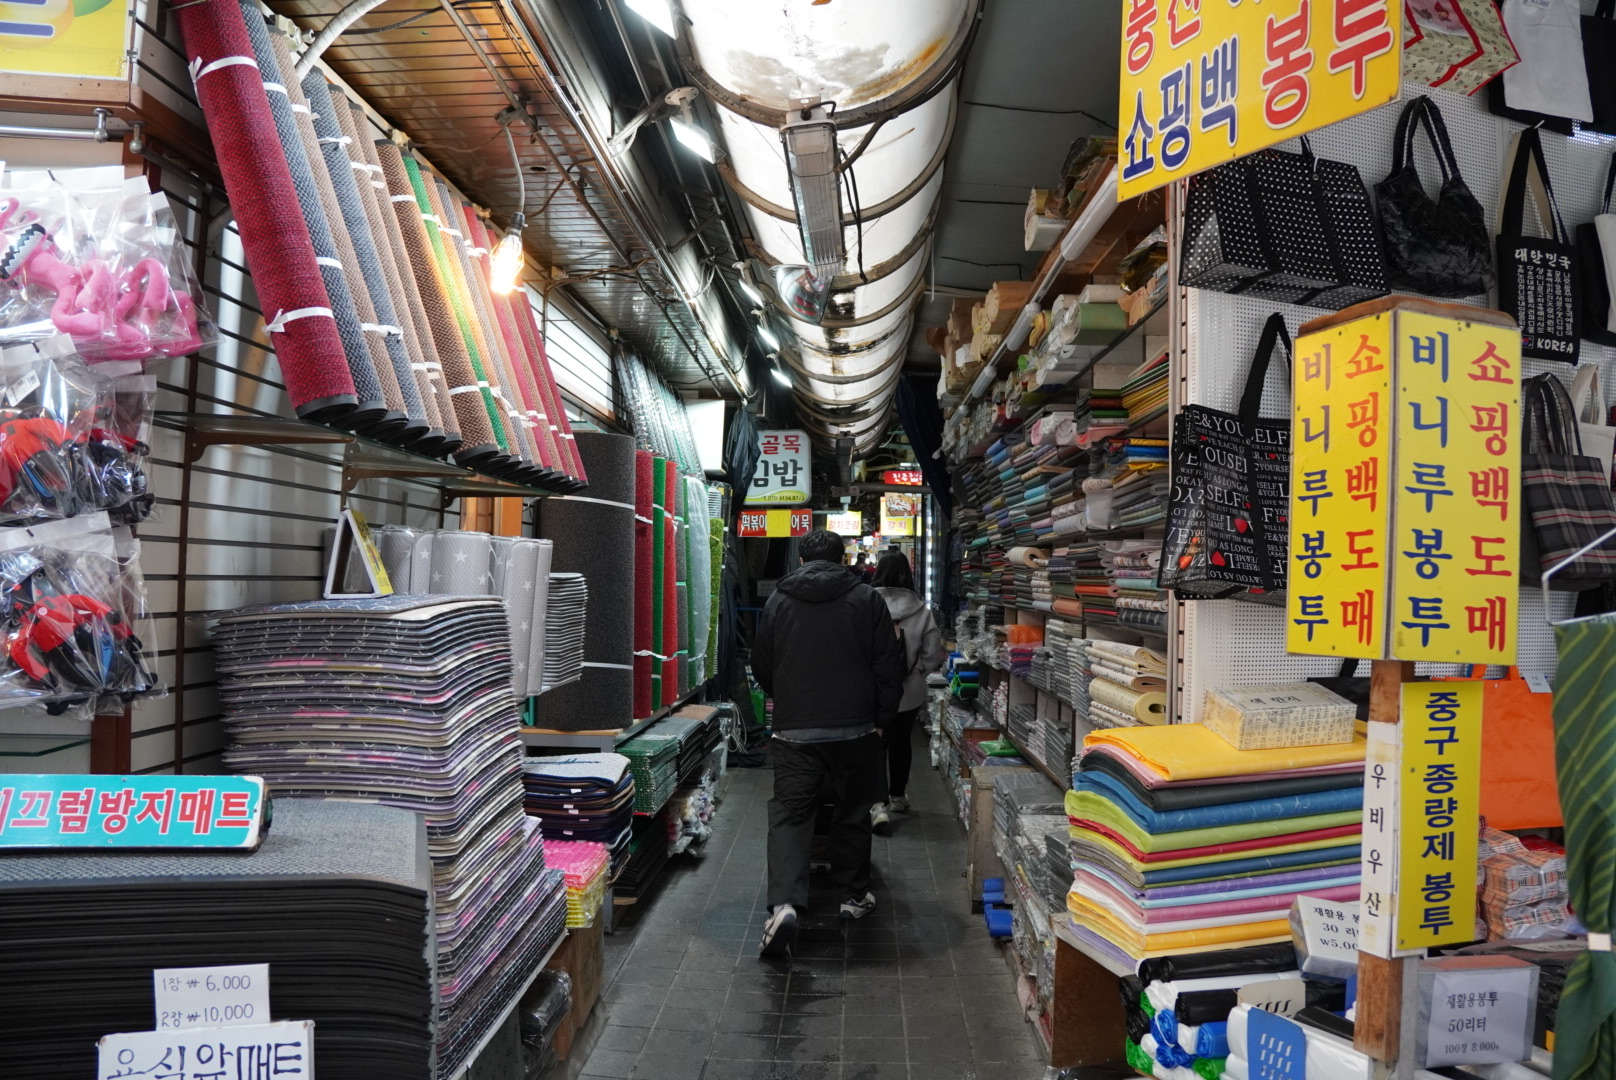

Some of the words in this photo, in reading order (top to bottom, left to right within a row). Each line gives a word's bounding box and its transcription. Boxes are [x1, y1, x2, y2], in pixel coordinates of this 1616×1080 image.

[1122, 36, 1238, 181] 쇼핑백
[1537, 338, 1574, 354] KOREA
[761, 435, 801, 455] 골목
[1294, 343, 1333, 643] 비니루봉투
[1340, 334, 1384, 647] 쇼핑백도매
[1401, 331, 1453, 647] 비니루봉투
[1464, 341, 1514, 653] 쇼핑백도매
[742, 514, 767, 532] 떡볶이
[791, 514, 810, 532] 어묵
[1424, 691, 1460, 756] 중구
[1421, 763, 1459, 861] 종량제
[1313, 907, 1345, 921] 재활용
[1323, 923, 1338, 933] 30
[1345, 927, 1359, 938] 리
[1418, 871, 1455, 936] 봉투
[162, 977, 182, 992] 1장
[161, 1010, 183, 1028] 2장
